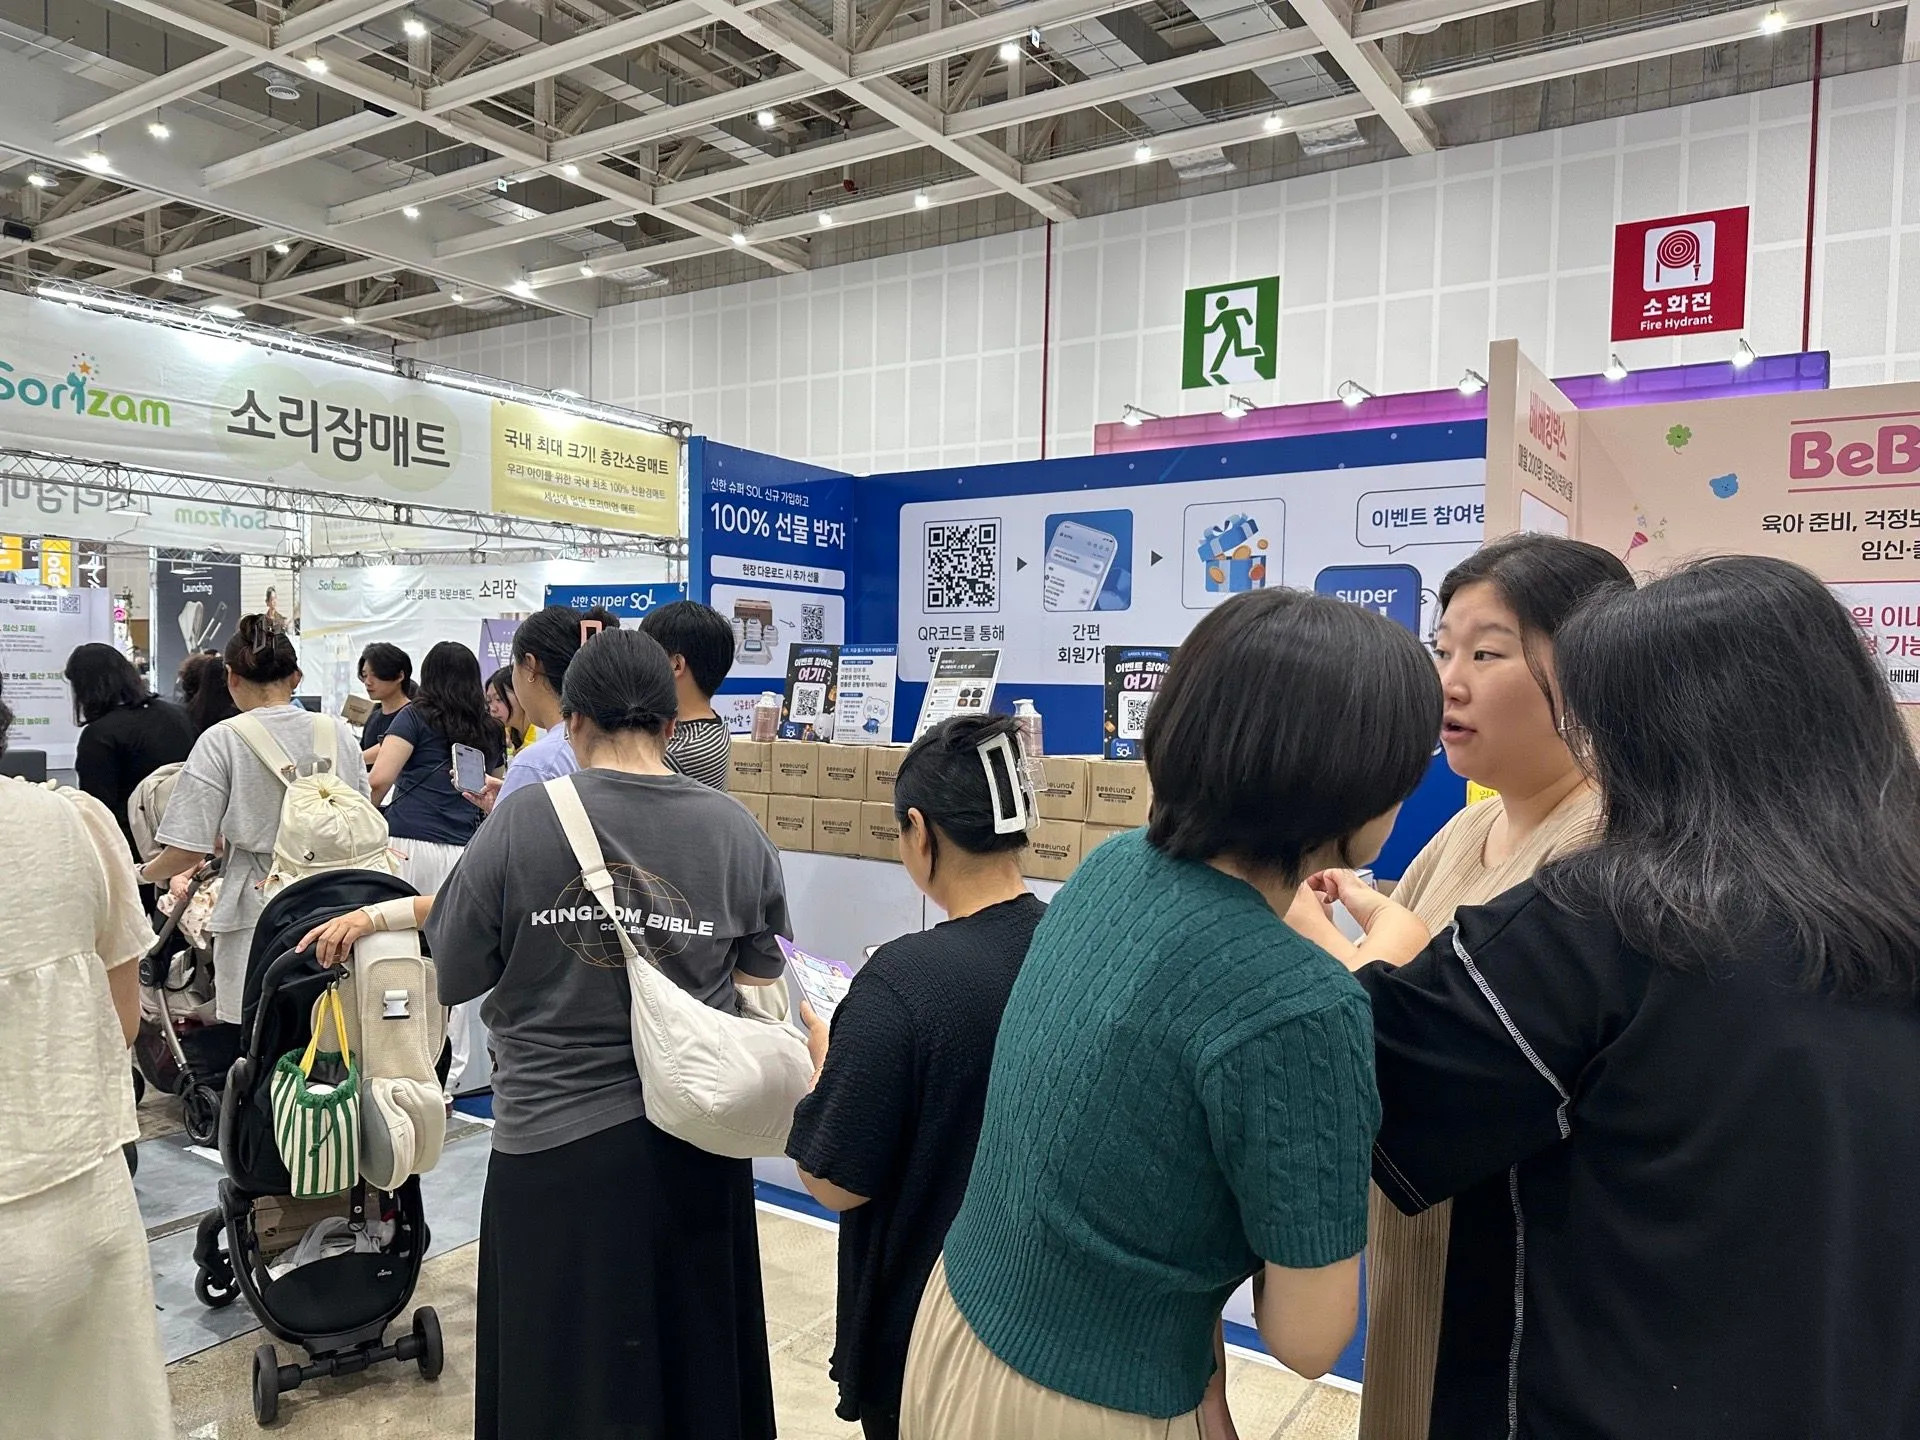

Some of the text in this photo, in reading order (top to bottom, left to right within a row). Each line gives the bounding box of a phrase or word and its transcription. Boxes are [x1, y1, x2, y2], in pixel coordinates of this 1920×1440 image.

[1643, 292, 1712, 316] 소화전
[1640, 314, 1713, 331] Fire Hydrant
[227, 389, 450, 468] 소리잠매트
[504, 428, 669, 475] 국내 최대 크기! 층간소음매트
[1790, 425, 1920, 479] BeB
[506, 462, 525, 476] 우리
[527, 465, 553, 482] 아이를
[555, 470, 572, 485] 위한
[574, 475, 590, 488] 국내
[592, 478, 608, 491] 최초
[610, 482, 630, 494] 100%
[711, 478, 810, 507] 신한 슈퍼 SOL 신규 가입하고
[710, 502, 846, 550] 100% 선물 받자
[1372, 507, 1427, 528] 이벤트
[1762, 513, 1804, 533] 육아
[1809, 511, 1857, 533] 준비,
[742, 564, 756, 576] 현장
[757, 566, 784, 579] 다운로드
[785, 570, 792, 579] 시
[793, 570, 807, 581] 추가
[182, 582, 213, 595] Launching
[478, 578, 518, 599] 소리잠
[570, 595, 589, 608] 신한
[590, 595, 628, 611] super
[918, 625, 1005, 641] QR코드를 통해
[1072, 624, 1100, 641] 간편
[798, 667, 826, 682] 여기!
[1115, 662, 1143, 673] 이벤트
[1890, 669, 1919, 683] 베베
[531, 905, 714, 936] KINGDOM BIBLE
